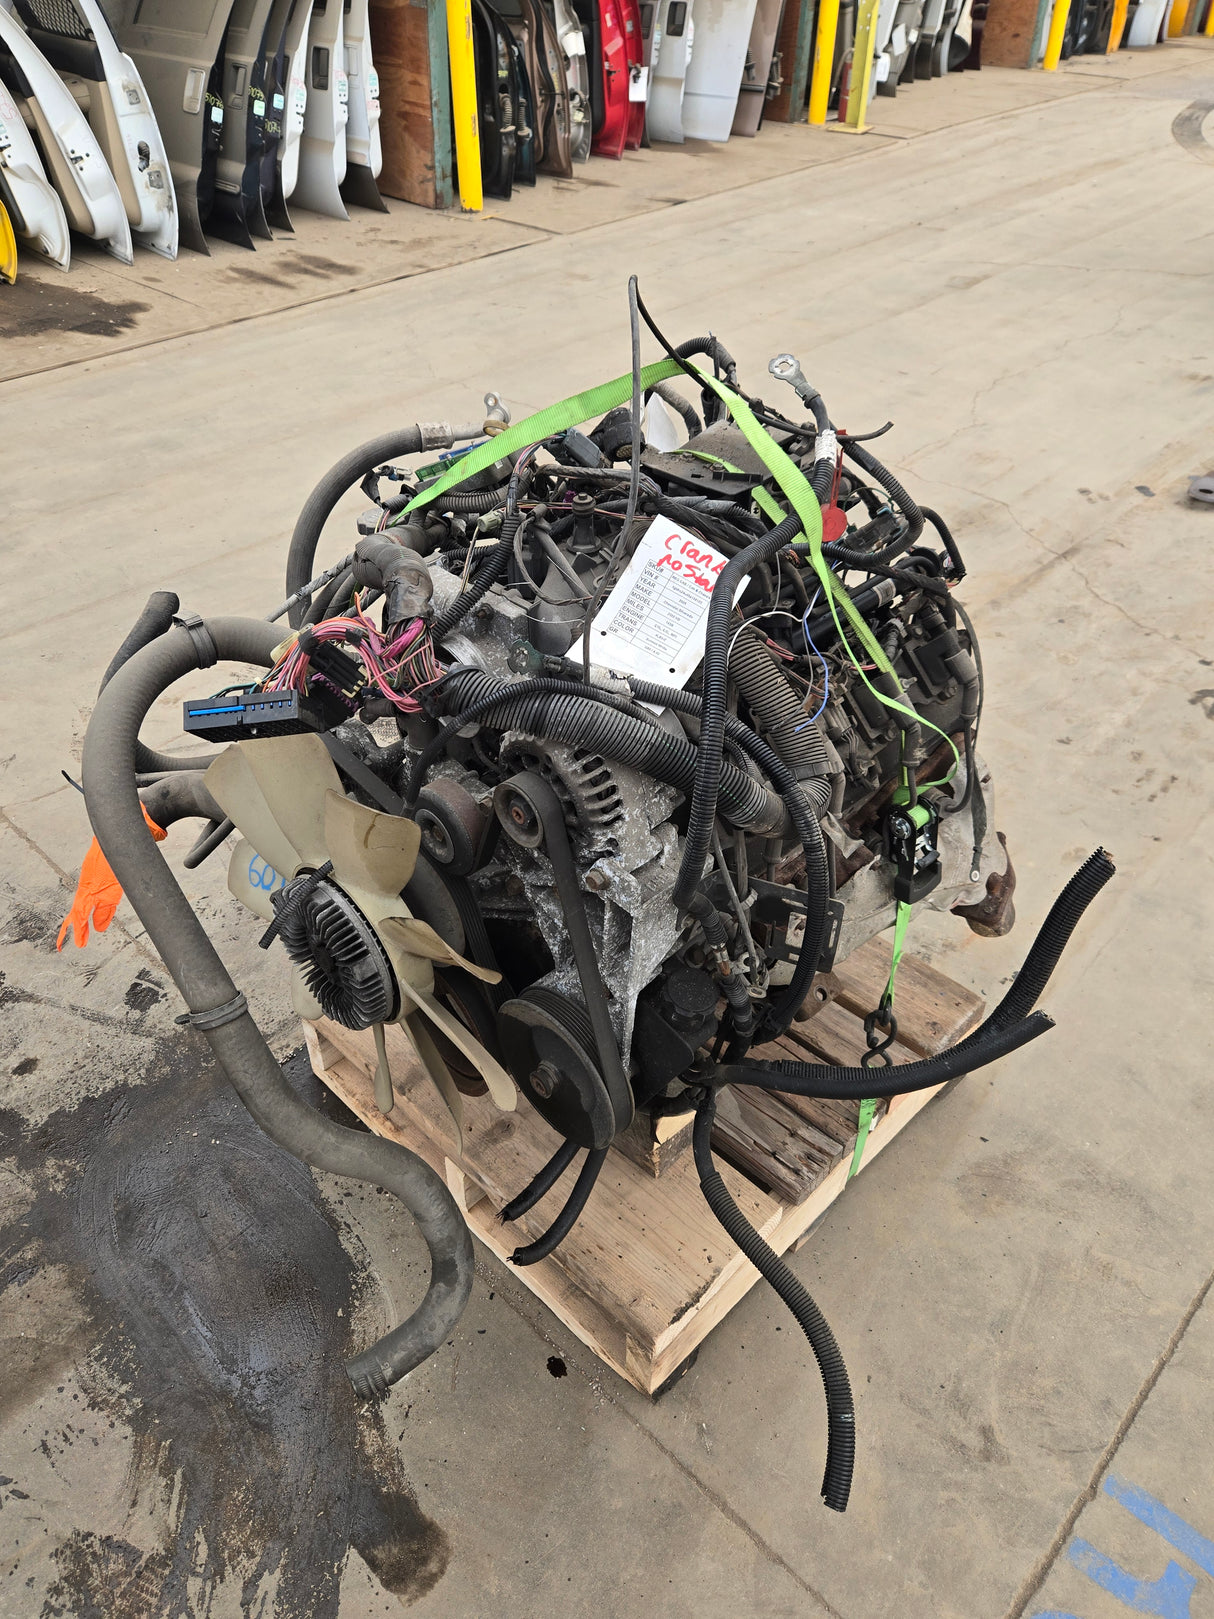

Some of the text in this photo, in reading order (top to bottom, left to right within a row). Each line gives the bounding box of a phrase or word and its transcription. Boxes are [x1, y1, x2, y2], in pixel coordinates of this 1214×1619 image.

[644, 568, 653, 578] VIN
[648, 562, 664, 573] SKU#
[640, 576, 656, 588] YEAR
[636, 584, 653, 596] MAKE
[627, 598, 644, 611] MILES
[631, 591, 651, 605] MODEL
[618, 613, 638, 626] TRANS
[622, 606, 644, 620] ENGINE
[613, 620, 634, 633] COLOR
